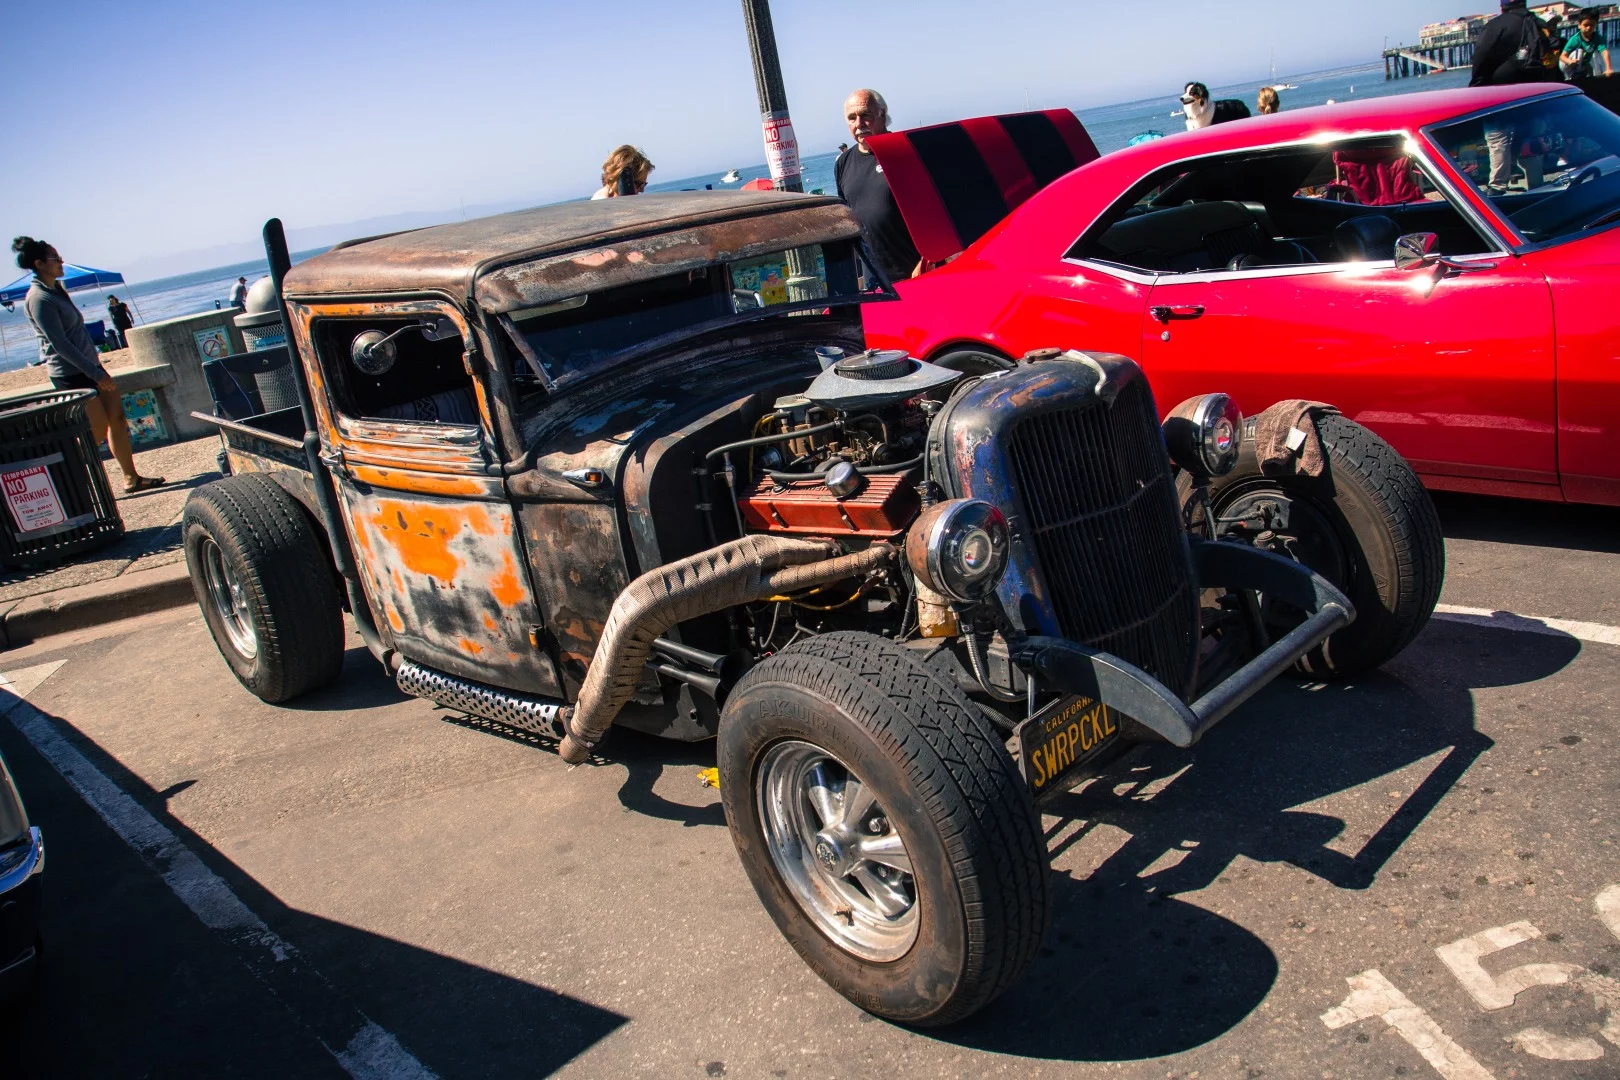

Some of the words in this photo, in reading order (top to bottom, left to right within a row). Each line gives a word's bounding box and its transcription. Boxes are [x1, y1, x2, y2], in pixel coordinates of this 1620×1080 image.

[765, 128, 779, 142] NO
[769, 140, 795, 151] PARKING
[3, 466, 42, 481] TEMPORARY
[6, 479, 26, 494] NO
[13, 488, 50, 505] PARKING
[37, 503, 53, 511] AWAY
[1046, 696, 1094, 732] CALIFORNI
[1032, 703, 1116, 787] SWRPCKL
